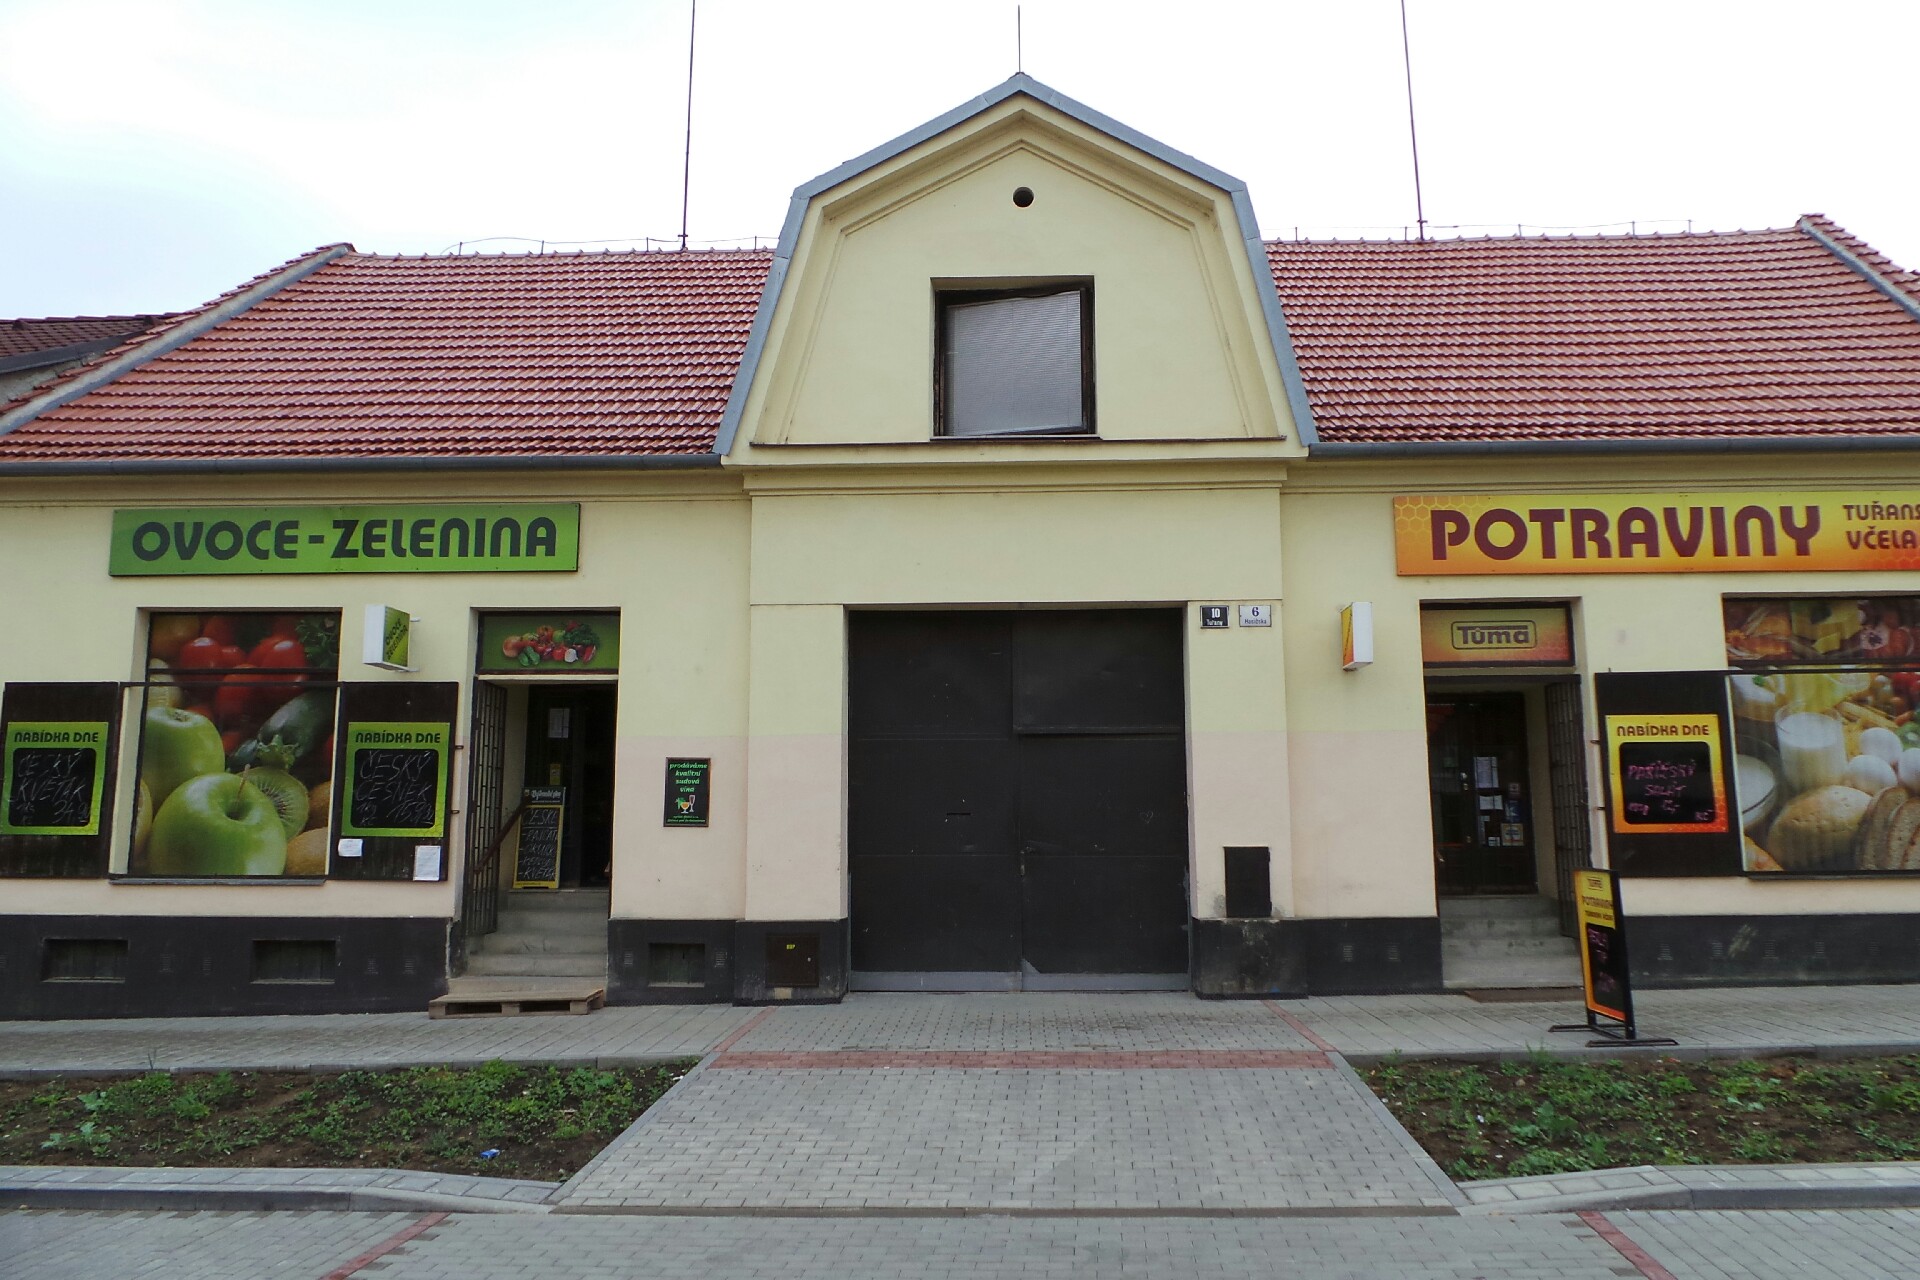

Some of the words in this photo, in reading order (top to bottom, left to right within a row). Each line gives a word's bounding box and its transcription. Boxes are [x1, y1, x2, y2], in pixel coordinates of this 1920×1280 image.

[1430, 505, 1821, 561] POTRAVINY
[1845, 525, 1918, 550] VČELA
[1211, 607, 1221, 619] 10
[1252, 606, 1260, 617] 6
[1457, 625, 1530, 645] Tůma
[14, 730, 70, 743] NABÍDKA
[73, 731, 99, 743] DNE
[1617, 722, 1678, 737] NABÍDKA
[1683, 724, 1710, 736] DNE
[355, 730, 412, 744] NABÍDKA
[415, 733, 441, 744] DNE
[669, 762, 708, 770] prodáváme
